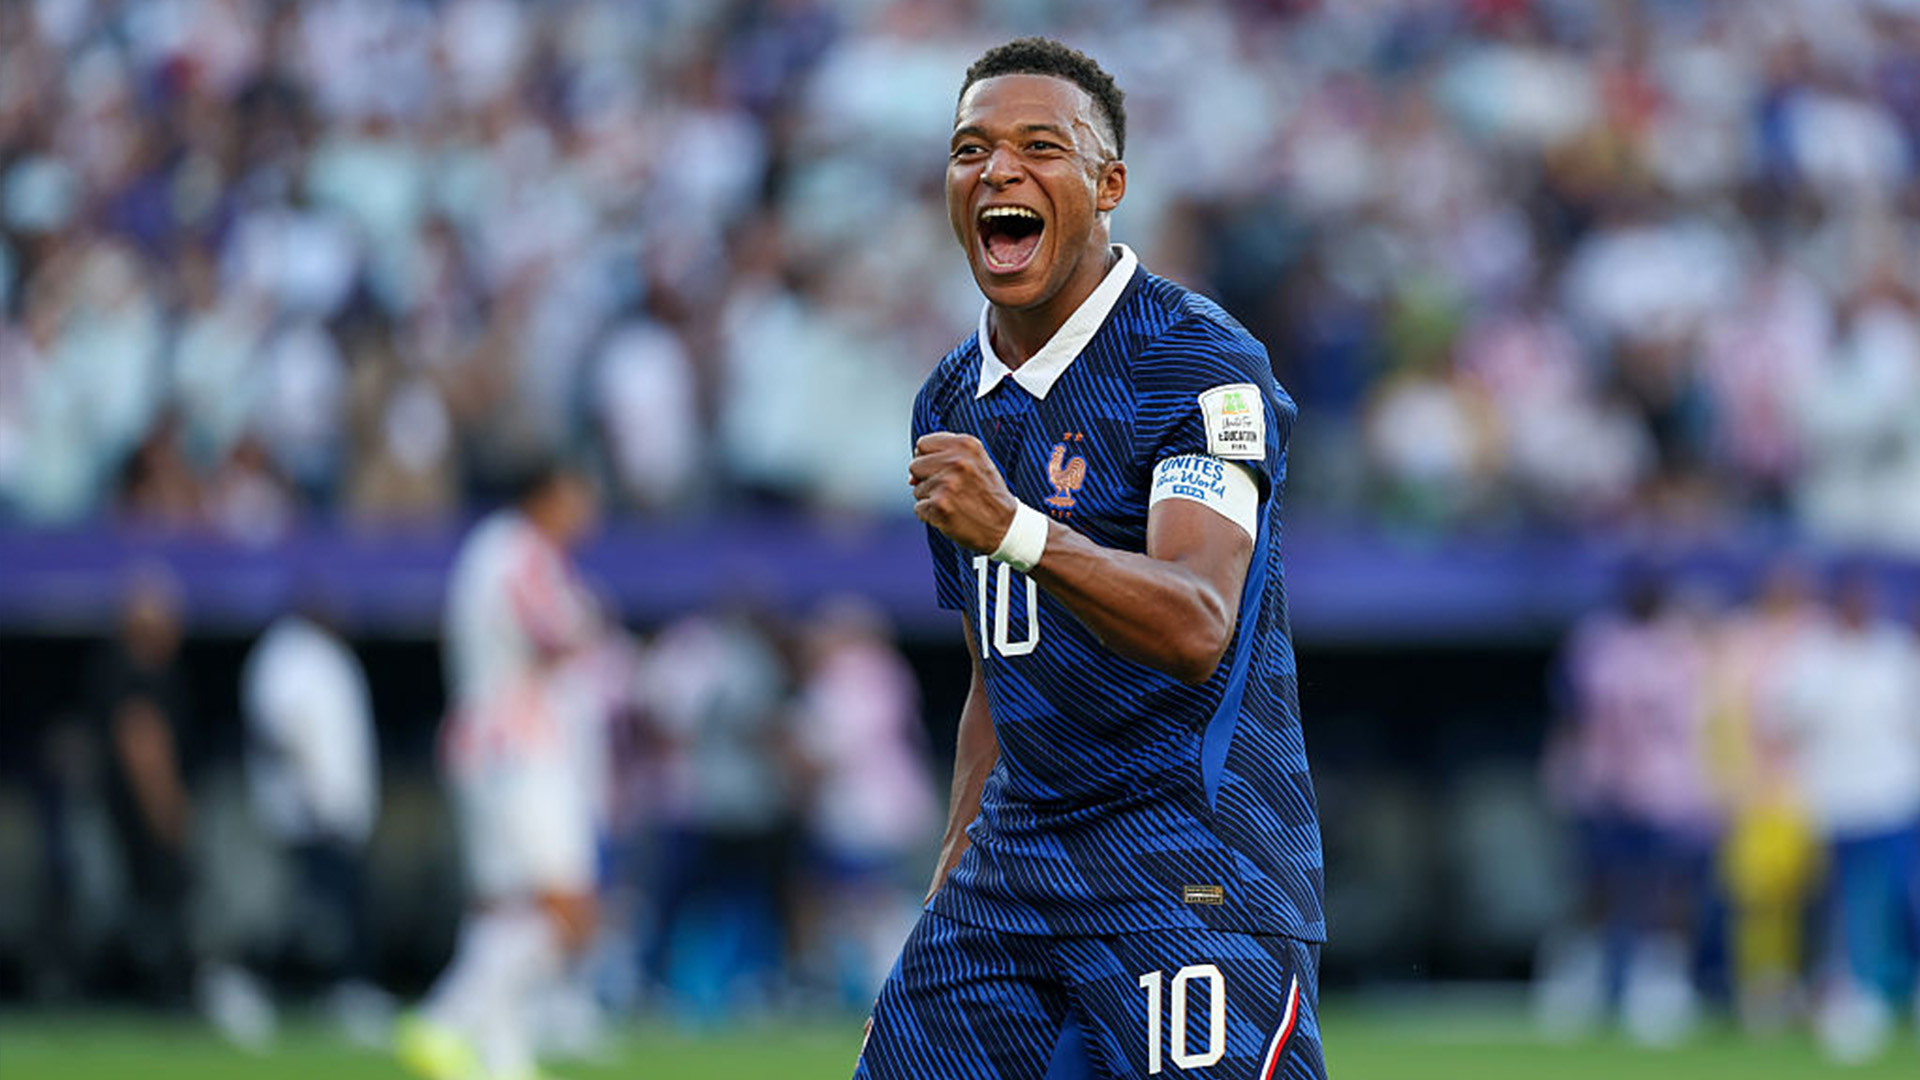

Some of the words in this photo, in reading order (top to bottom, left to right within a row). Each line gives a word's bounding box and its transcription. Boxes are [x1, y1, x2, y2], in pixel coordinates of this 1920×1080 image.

[1161, 457, 1224, 481] UNITES
[1181, 470, 1226, 499] World
[973, 555, 1040, 659] 10
[1138, 963, 1226, 1075] 10
